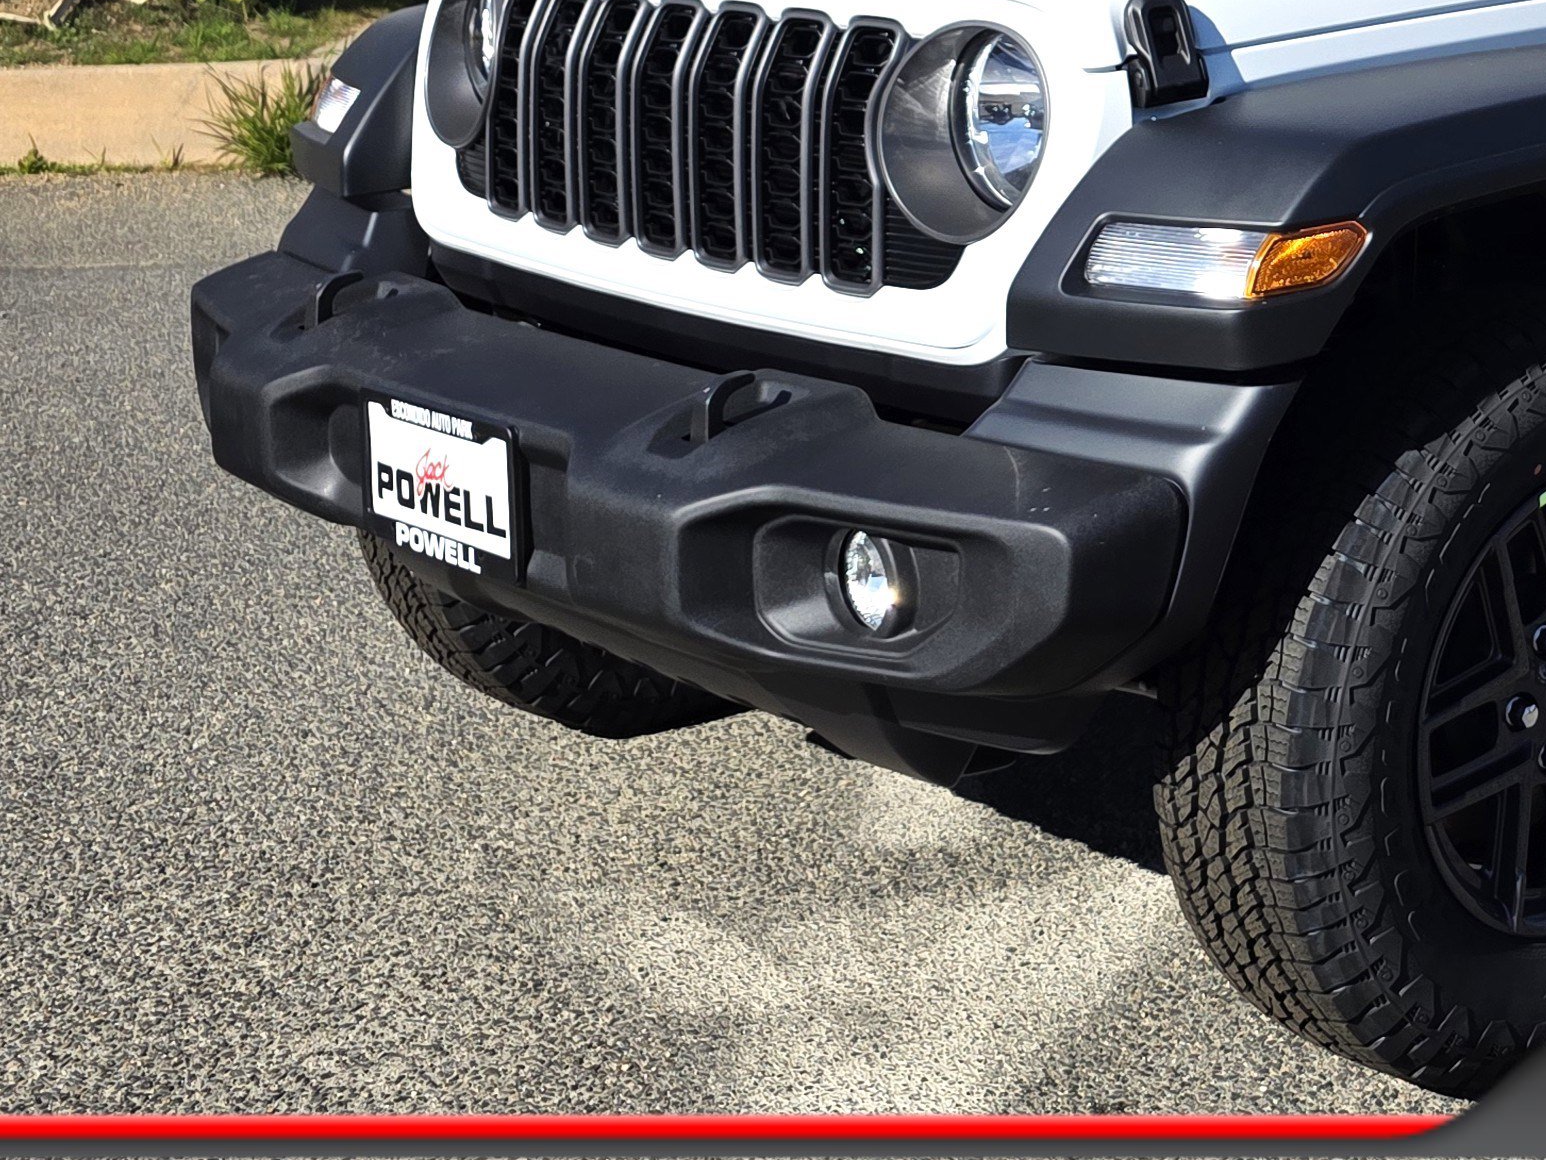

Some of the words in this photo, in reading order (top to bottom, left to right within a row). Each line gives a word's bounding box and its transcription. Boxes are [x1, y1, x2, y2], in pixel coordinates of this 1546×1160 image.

[431, 411, 451, 434] AUTO
[415, 448, 453, 496] Jack
[377, 461, 507, 538] POWELL
[395, 522, 482, 575] POWELL
